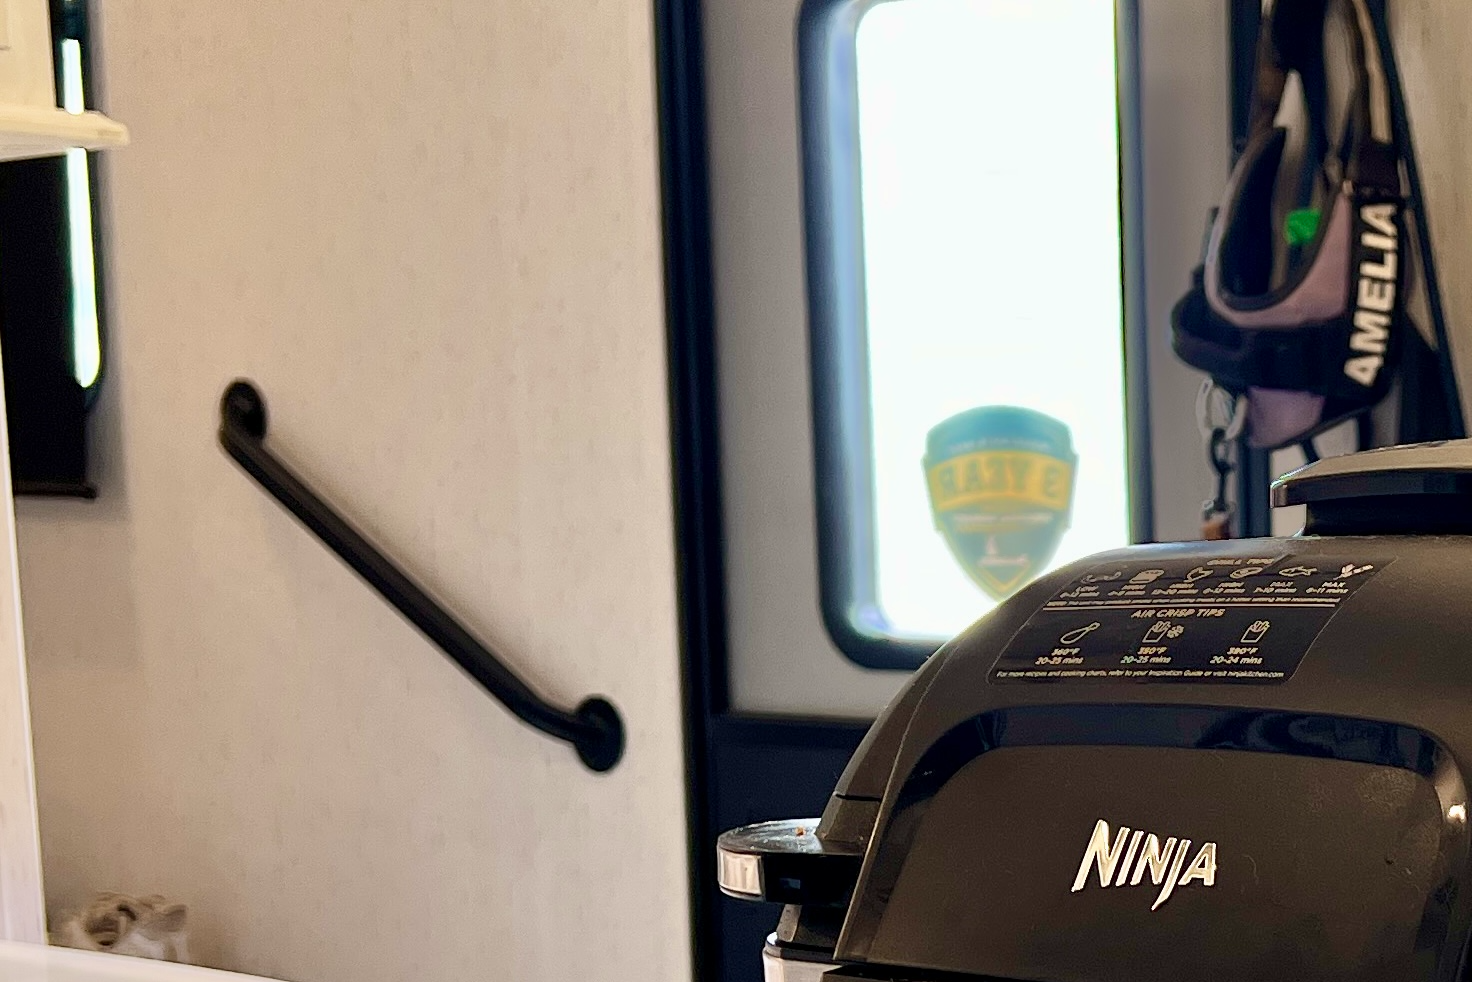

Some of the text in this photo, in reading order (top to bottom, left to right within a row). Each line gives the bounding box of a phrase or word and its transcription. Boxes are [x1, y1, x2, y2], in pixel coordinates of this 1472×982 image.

[1343, 203, 1398, 387] AMELIA
[1131, 608, 1226, 618] AIR CRISP TIPS
[1149, 655, 1172, 664] mins
[1239, 656, 1263, 664] mins
[1070, 819, 1217, 911] NINJA
